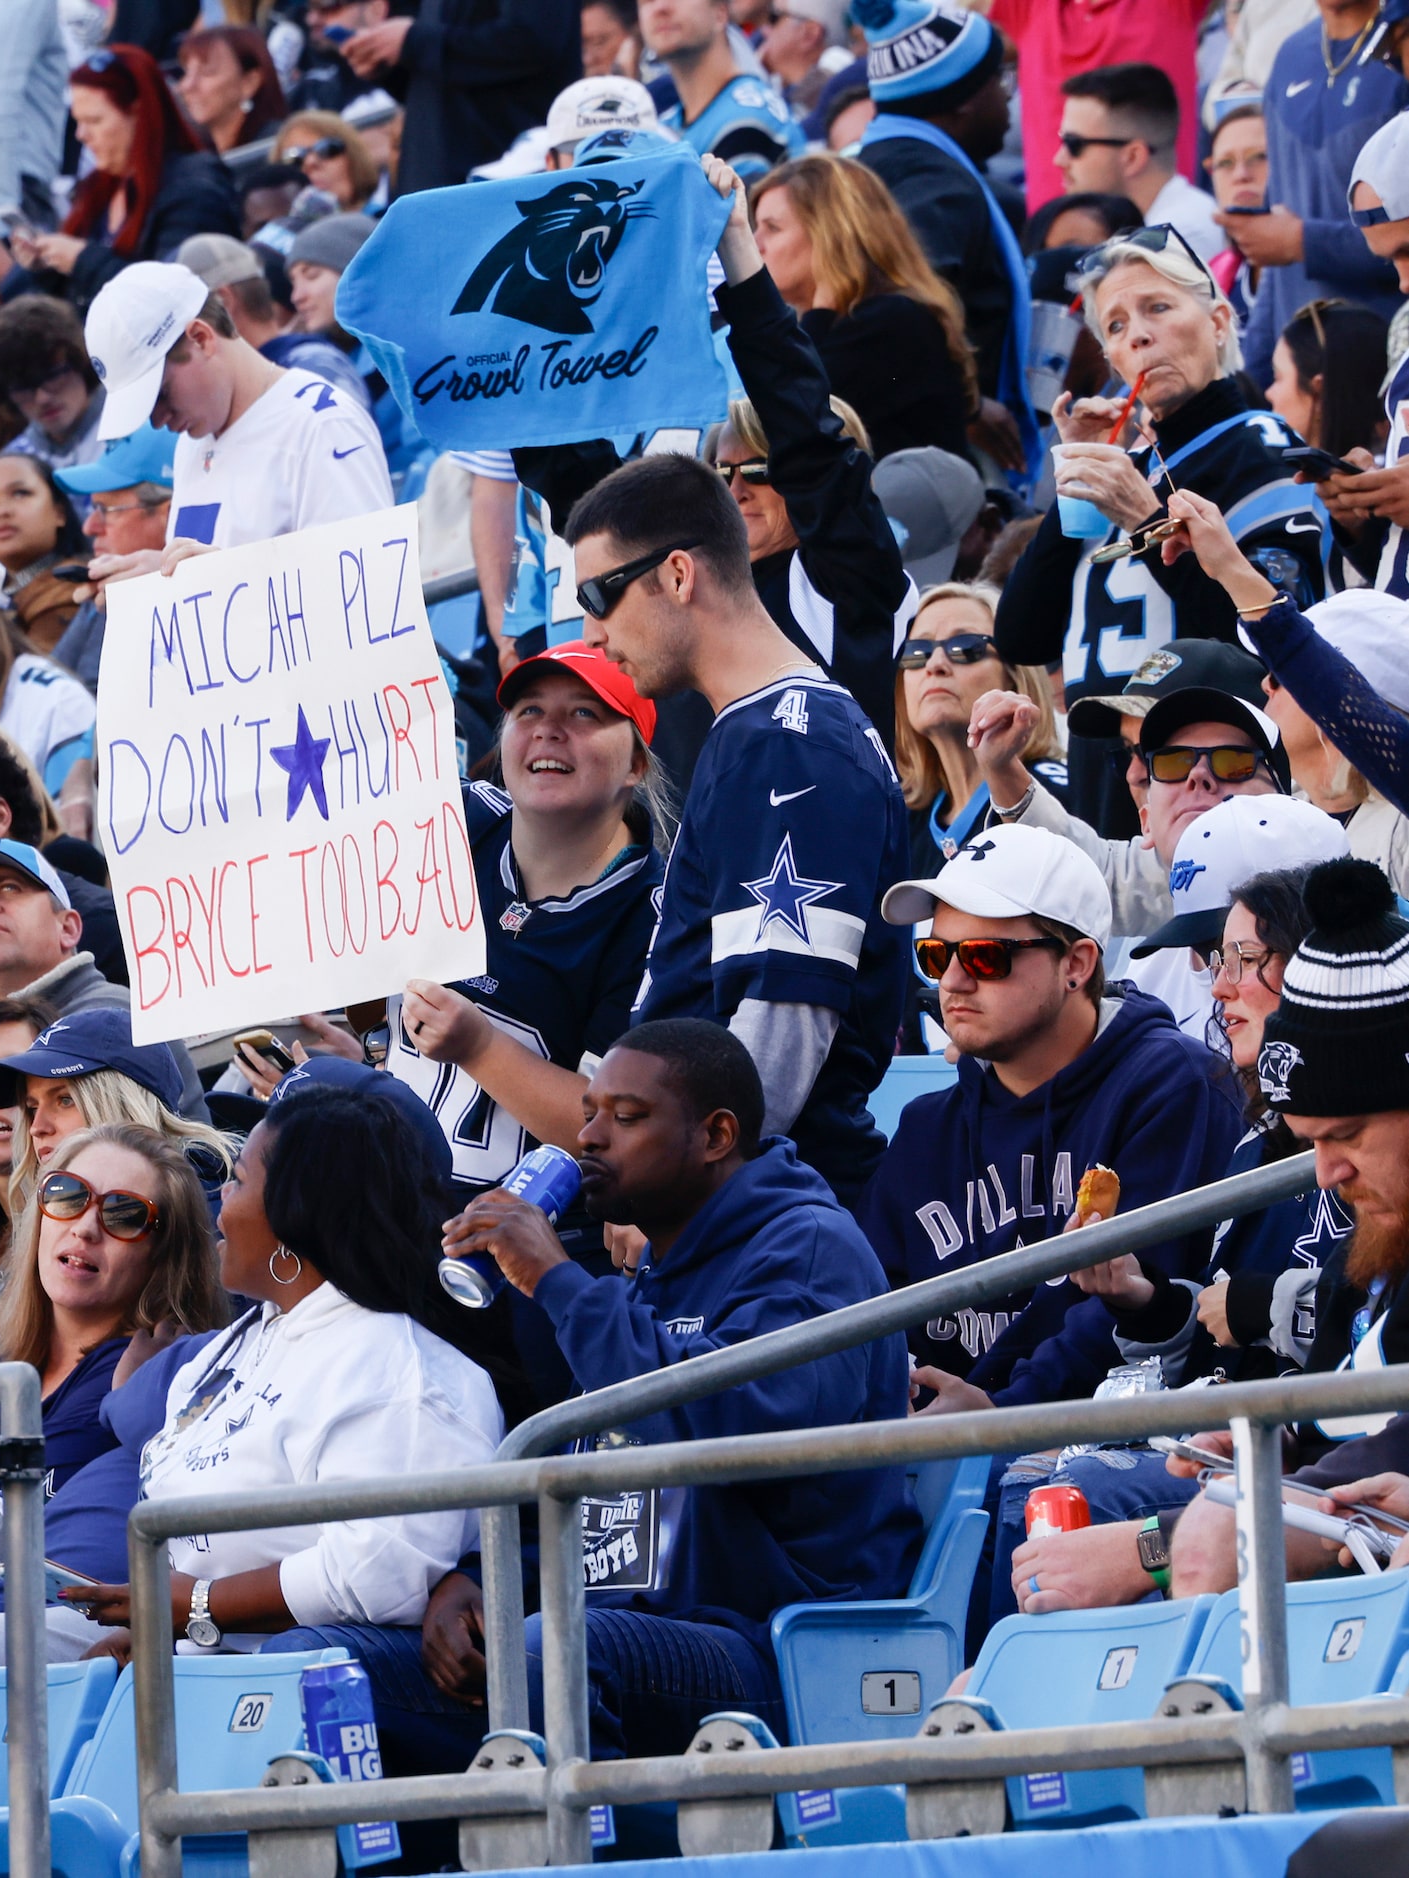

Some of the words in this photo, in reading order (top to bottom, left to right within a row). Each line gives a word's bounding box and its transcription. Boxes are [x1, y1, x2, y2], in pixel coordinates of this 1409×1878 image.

[413, 344, 531, 406] Growl
[540, 325, 659, 391] Towel
[466, 351, 512, 368] OFFICIAL
[148, 568, 312, 708] MICAH
[339, 538, 416, 650] PLZ
[772, 689, 809, 735] 4
[108, 714, 271, 855] DON'T
[328, 676, 440, 810] HURT
[126, 853, 273, 1011] BRYCE
[50, 1063, 85, 1075] COWBOYS
[915, 1151, 1074, 1261] DALLA
[584, 1529, 640, 1584] BOYS
[1337, 1628, 1353, 1656] 2
[883, 1679, 896, 1707] 1
[1113, 1656, 1125, 1684] 1
[238, 1702, 264, 1727] 20
